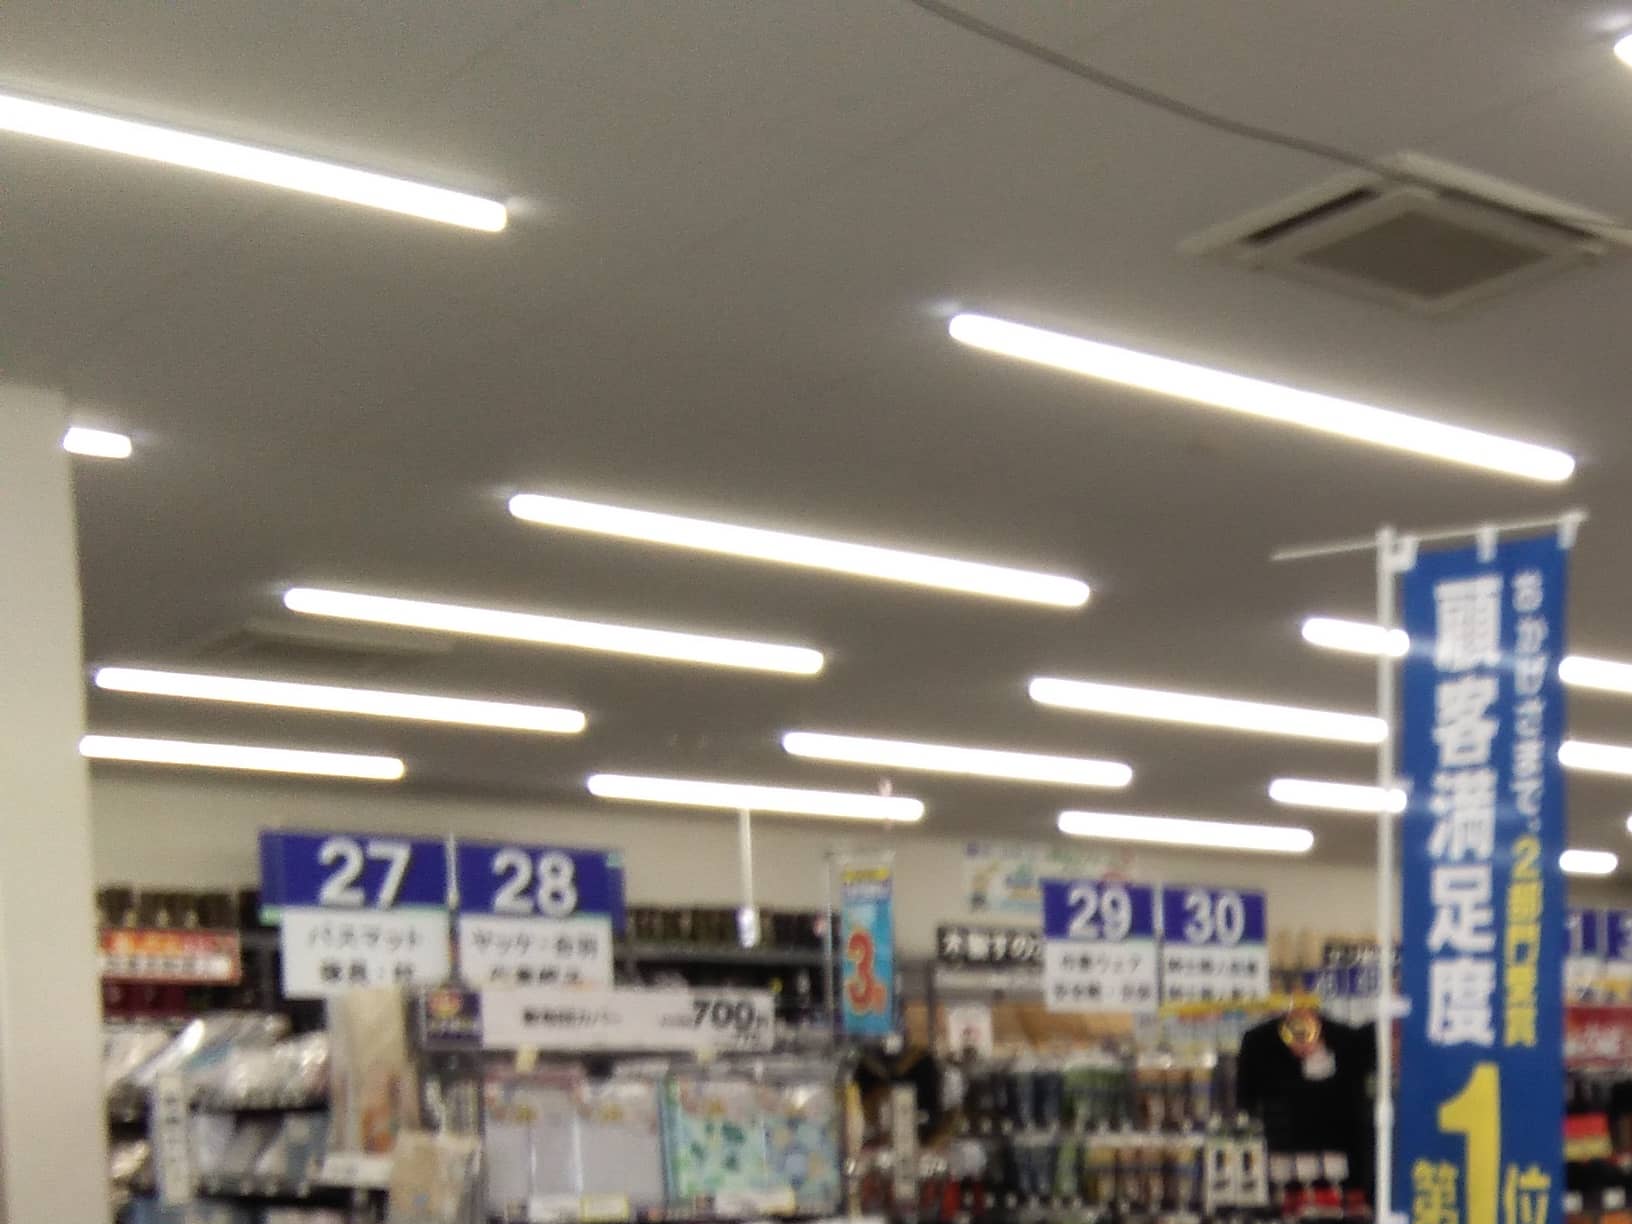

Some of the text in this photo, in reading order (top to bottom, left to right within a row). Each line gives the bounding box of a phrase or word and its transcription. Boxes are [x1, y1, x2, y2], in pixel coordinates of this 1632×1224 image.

[1427, 572, 1503, 1047] 顧客満足度
[317, 836, 412, 911] 27
[491, 849, 579, 918] 28
[1067, 882, 1133, 941] 29
[1185, 890, 1247, 945] 30
